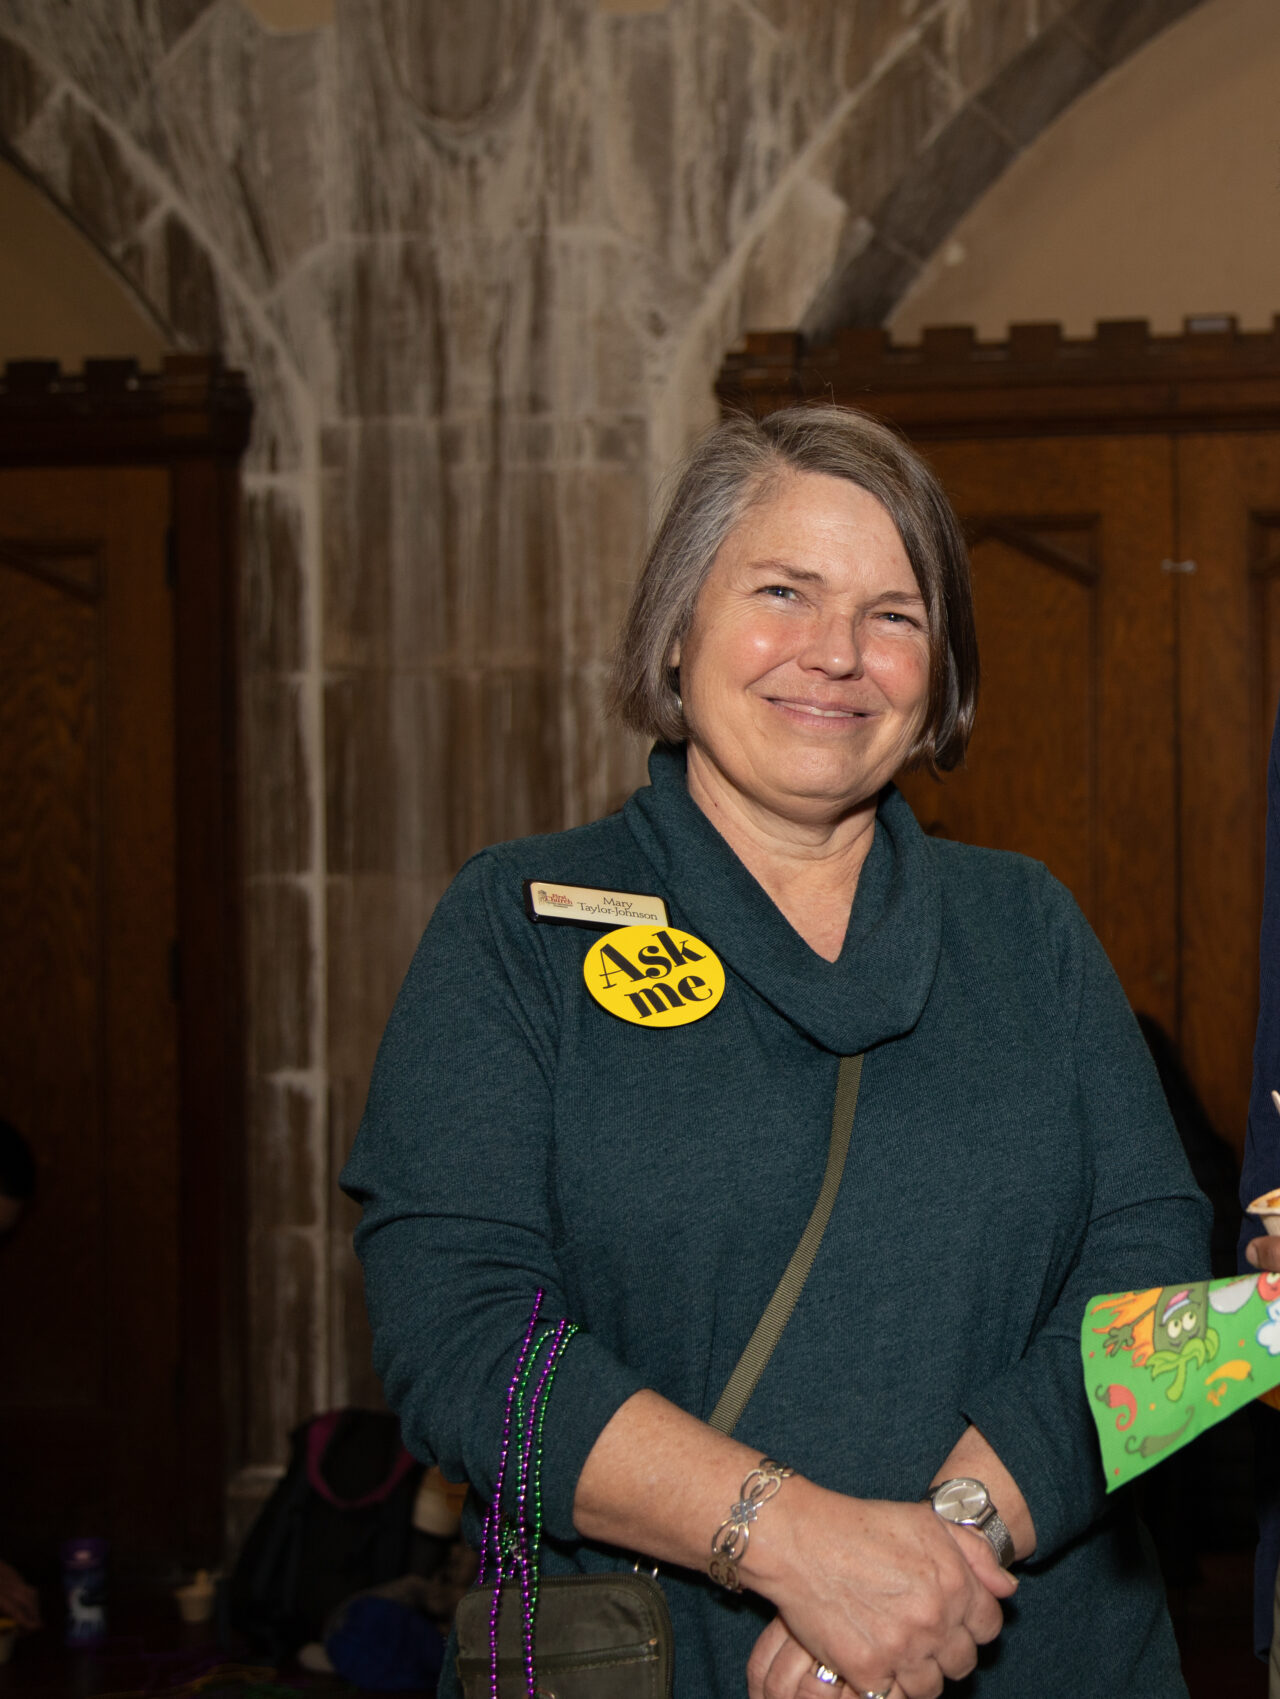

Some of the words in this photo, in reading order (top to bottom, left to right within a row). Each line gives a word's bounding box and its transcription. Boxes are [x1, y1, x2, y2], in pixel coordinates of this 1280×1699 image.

[577, 901, 658, 920] Taylor-Johnson
[603, 896, 633, 909] Mary
[600, 930, 706, 989] Ask
[624, 975, 713, 1018] me
